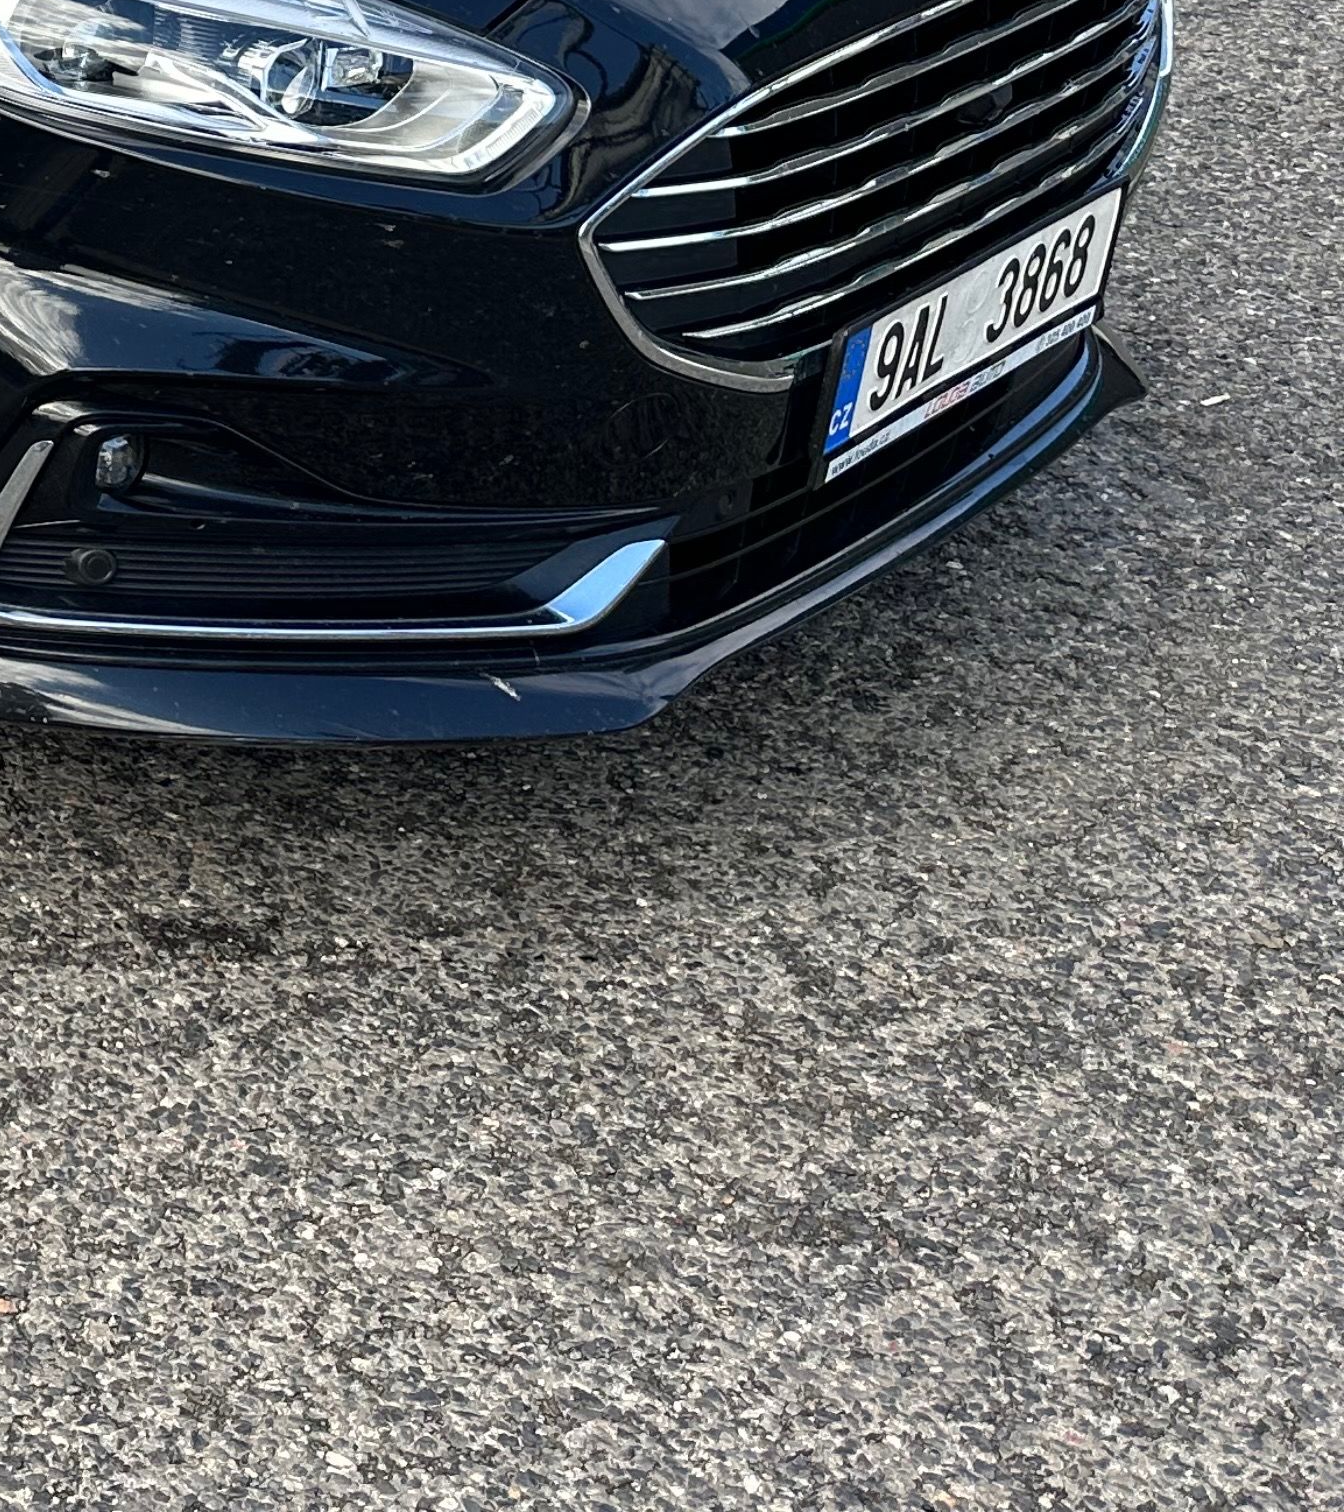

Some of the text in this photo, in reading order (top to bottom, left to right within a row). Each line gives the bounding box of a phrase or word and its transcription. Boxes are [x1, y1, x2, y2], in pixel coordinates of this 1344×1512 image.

[869, 294, 948, 411] 9AL
[986, 214, 1096, 343] 3868
[828, 401, 852, 435] CZ
